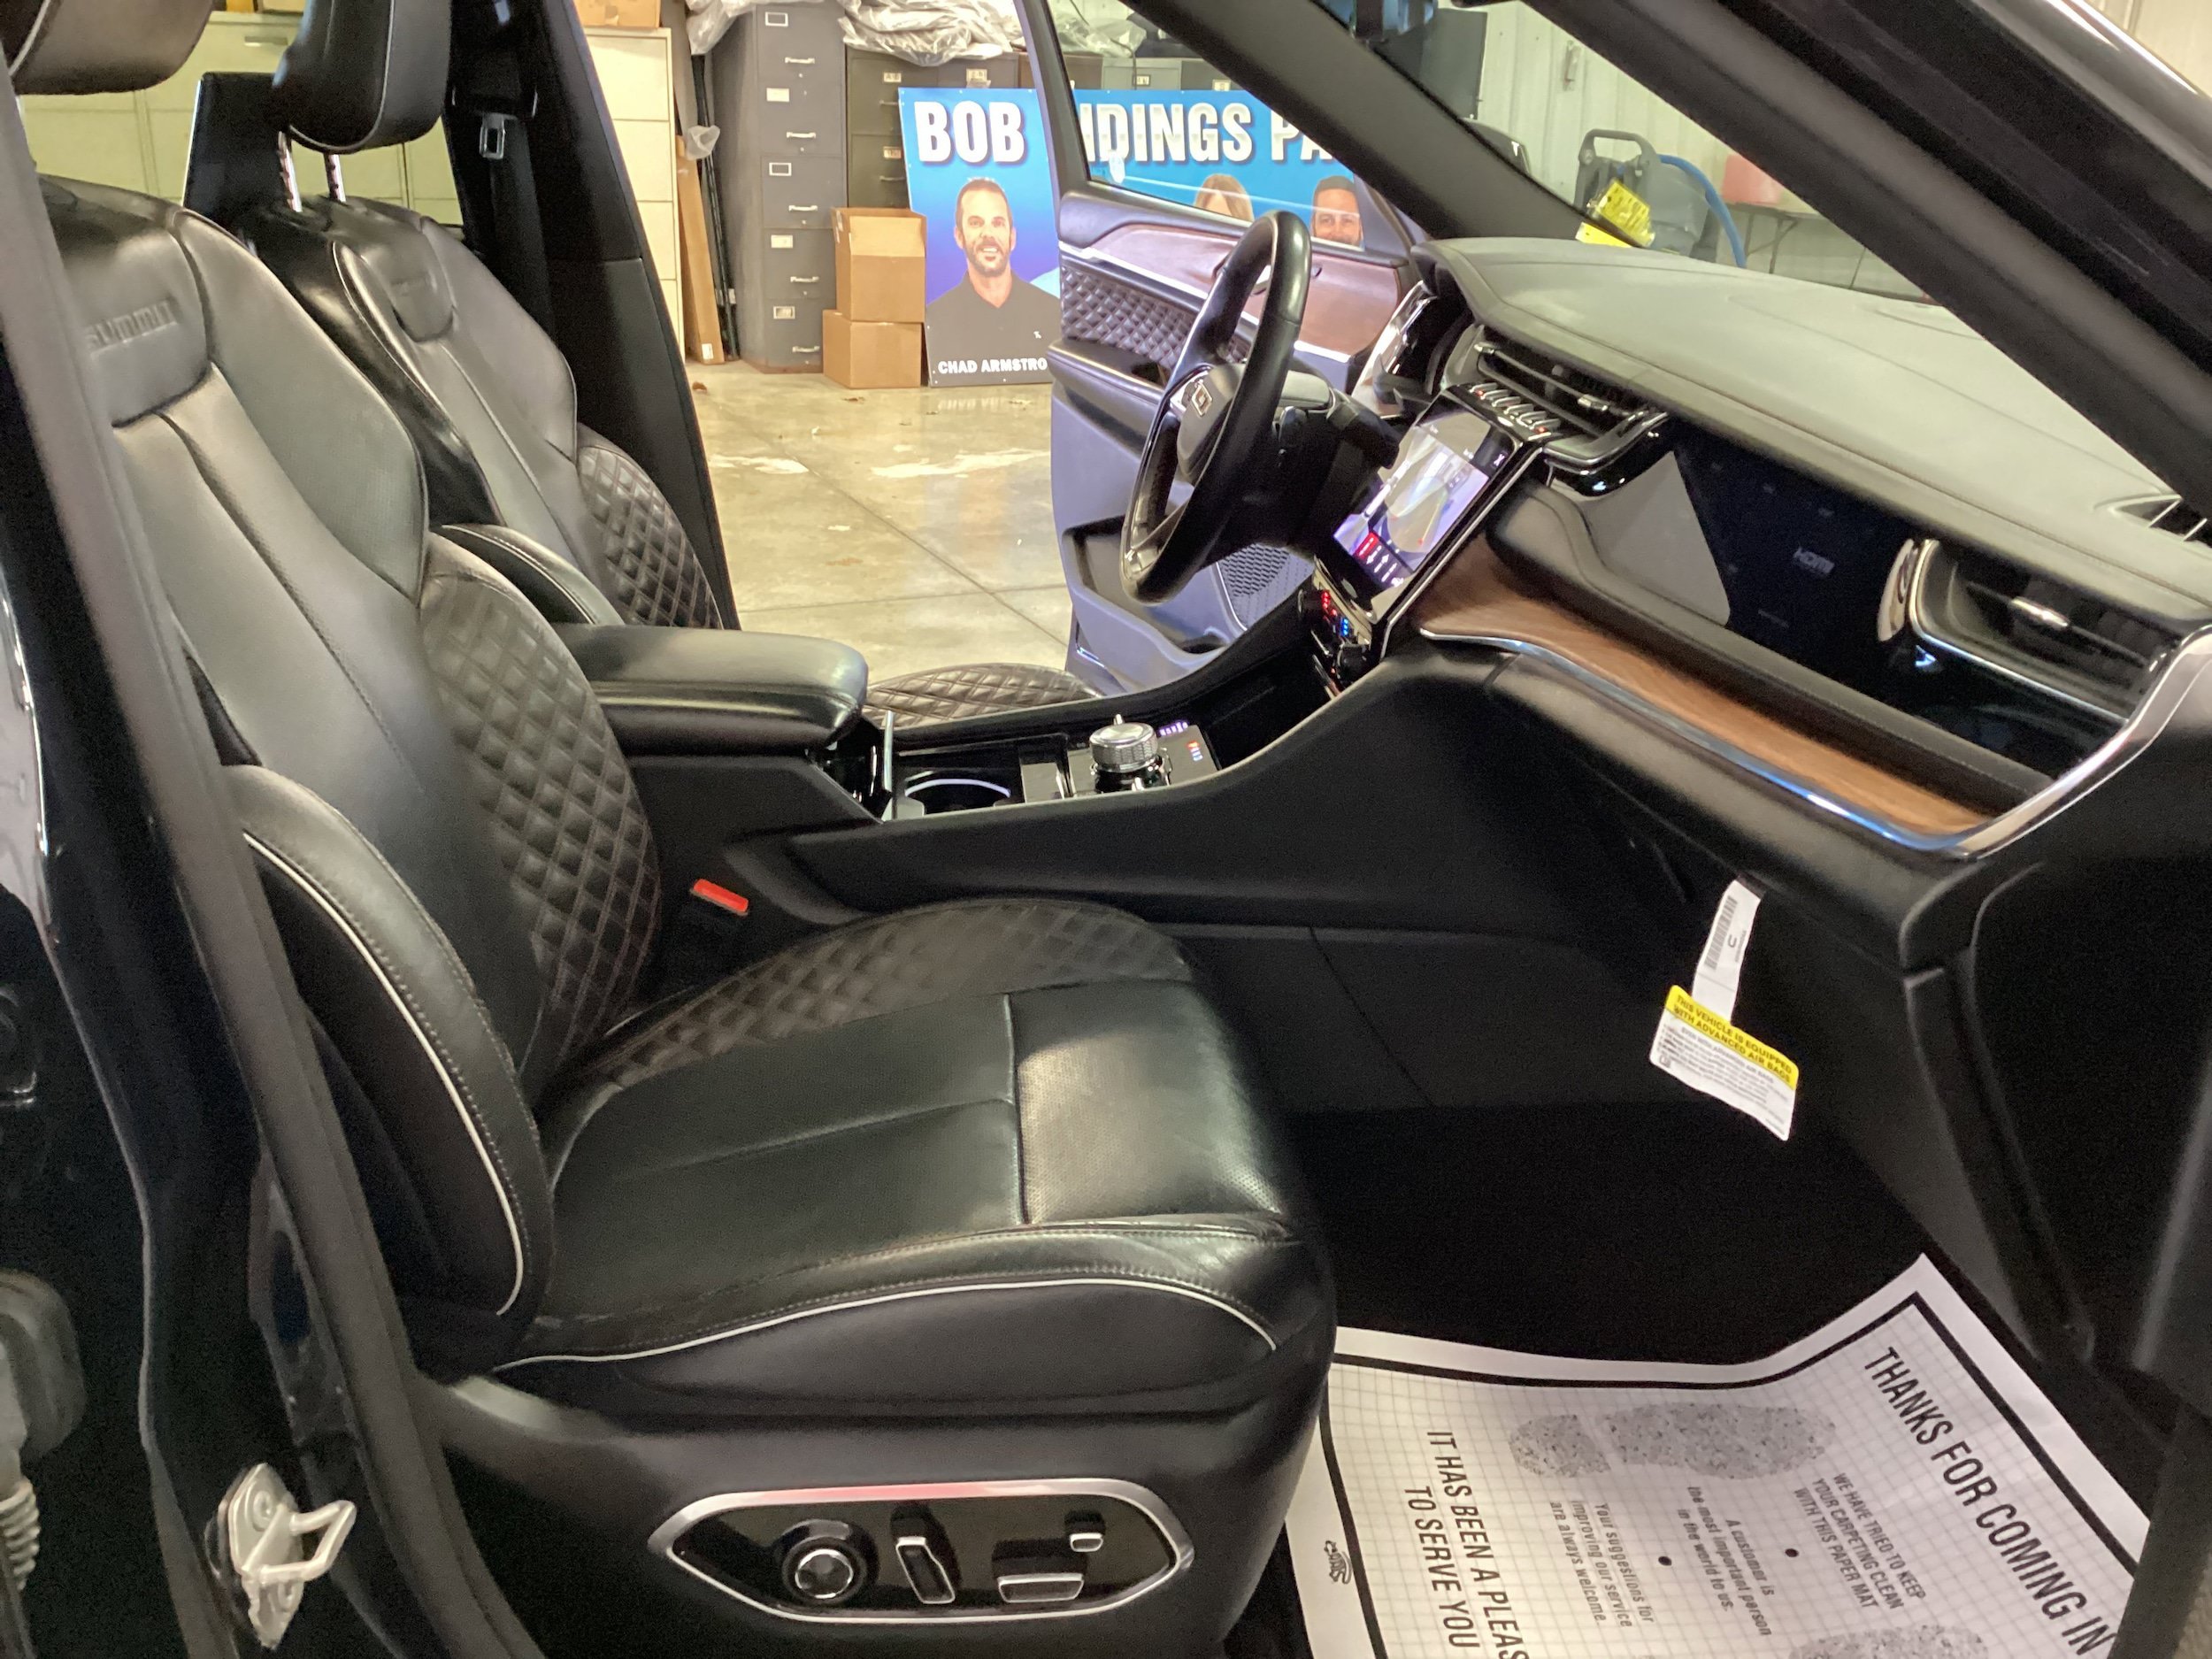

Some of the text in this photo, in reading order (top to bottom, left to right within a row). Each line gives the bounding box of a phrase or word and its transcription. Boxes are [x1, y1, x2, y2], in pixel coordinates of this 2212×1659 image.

[914, 100, 1025, 163] BOB
[1079, 102, 1252, 162] IDINGS
[938, 357, 1048, 374] CHAD ARMSTRO
[1673, 1005, 1791, 1083] WITH ADVANCED AIR BAGS
[1677, 995, 1793, 1074] THIS VEHICLE IS EQUIPPED
[1427, 1432, 1529, 1659] IT HAS BEEN A PLEAS
[1678, 1509, 1690, 1519] in
[1683, 1523, 1701, 1540] the
[1687, 1486, 1772, 1636] the most important person
[1694, 1543, 1721, 1576] world
[1793, 1486, 1879, 1608] WITH THIS PAPER MAT
[1812, 1478, 1904, 1609] YOUR CARPETING CLEAN
[1833, 1472, 1926, 1599] WE HAVE TRIED TO KEEP
[1864, 1346, 2118, 1656] THANKS FOR COMING IN
[1404, 1486, 1480, 1648] TO SERVE YOU
[1550, 1502, 1607, 1625] are always welcome.
[1571, 1500, 1632, 1627] improving our service
[1594, 1502, 1655, 1623] Your suggestions for
[1710, 1578, 1724, 1591] to
[1731, 1530, 1767, 1582] customer
[1761, 1586, 1775, 1596] is
